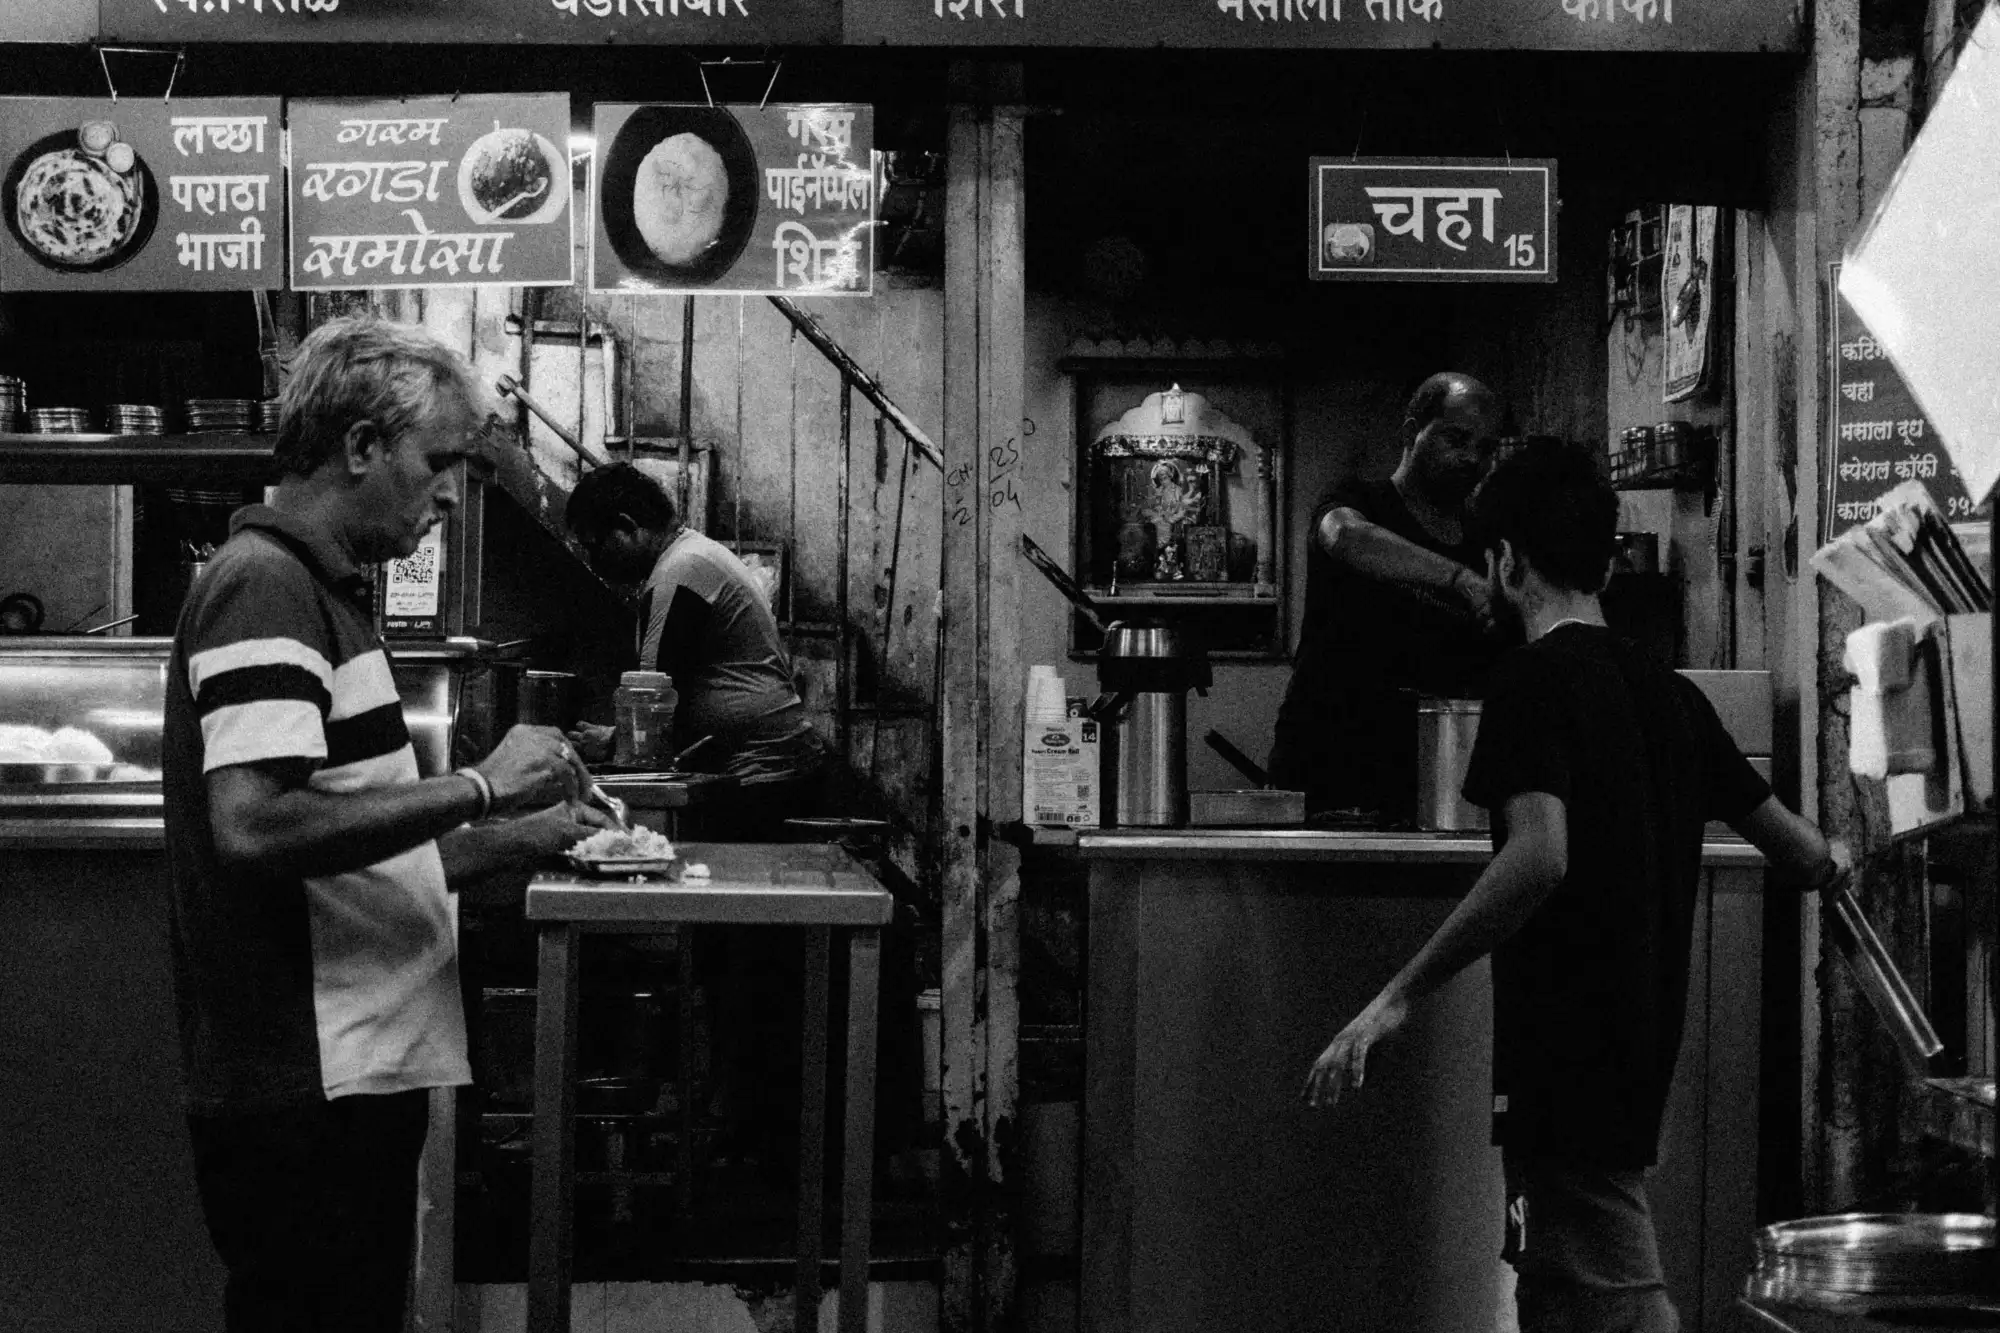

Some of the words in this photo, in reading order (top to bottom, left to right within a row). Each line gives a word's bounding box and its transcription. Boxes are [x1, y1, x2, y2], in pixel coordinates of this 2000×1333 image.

[170, 116, 268, 155] लच्छा
[336, 118, 449, 147] गरम
[787, 111, 856, 148] गरम
[170, 175, 269, 216] पराठा
[302, 161, 449, 203] रगडा
[1364, 187, 1503, 251] चहा
[176, 216, 265, 271] भाजी
[303, 208, 515, 279] समोसा
[1503, 234, 1536, 267] 15
[1841, 380, 1875, 402] चहा
[1840, 420, 1893, 441] मसाला
[1897, 419, 1924, 446] दूध
[1839, 456, 1890, 481] स्पेशल
[1895, 453, 1938, 478] कॉफी
